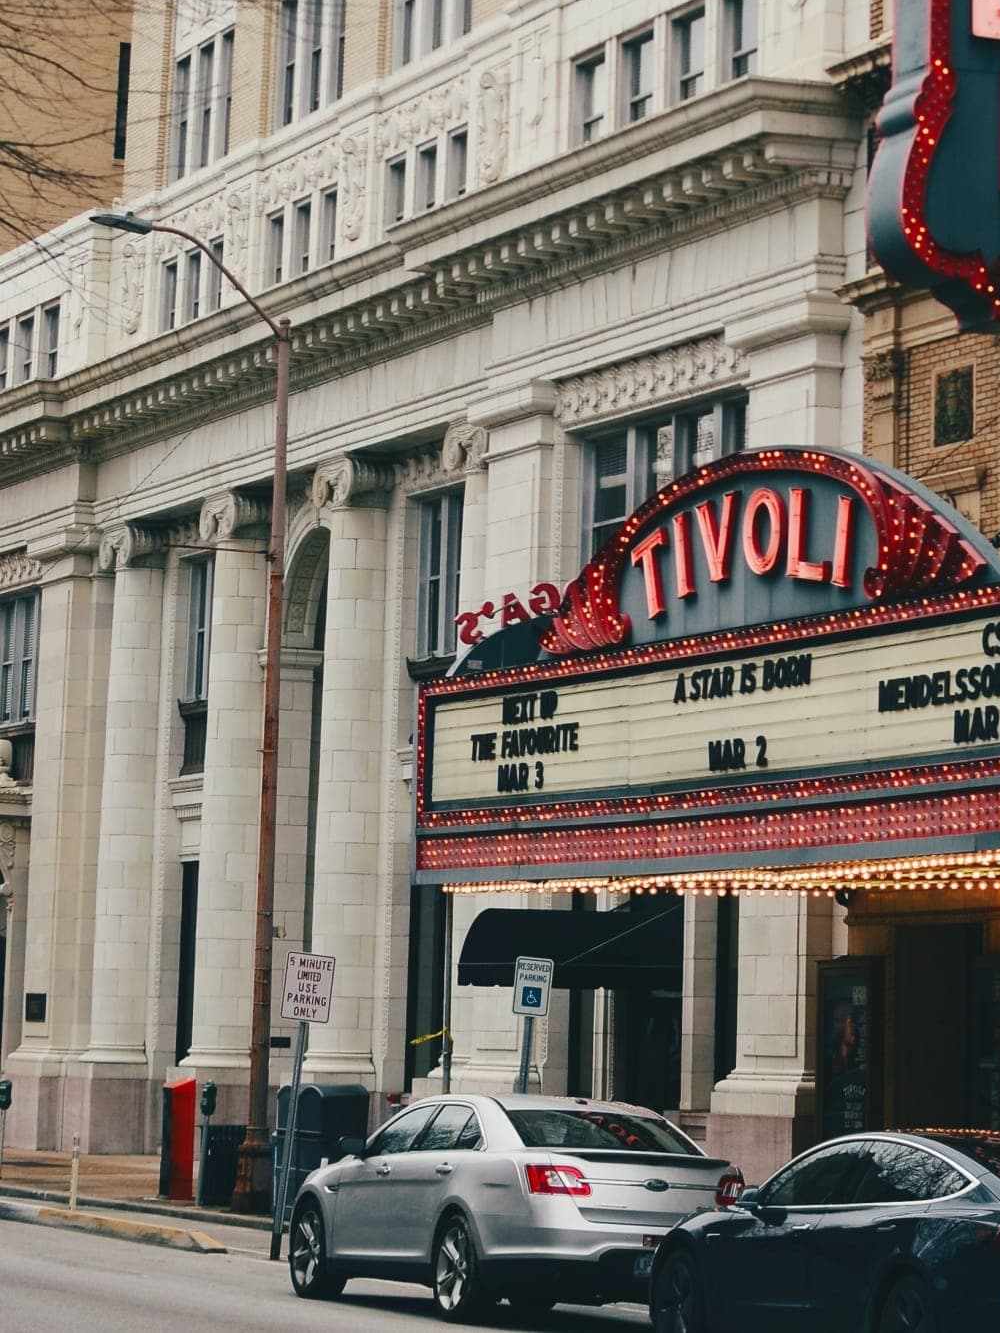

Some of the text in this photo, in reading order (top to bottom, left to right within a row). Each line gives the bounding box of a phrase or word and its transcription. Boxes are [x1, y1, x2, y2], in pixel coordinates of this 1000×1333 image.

[630, 487, 855, 620] TIVOLI
[673, 653, 813, 704] A STAR IS BORN
[502, 690, 558, 725] NEXT UP
[953, 703, 1000, 745] MAR
[471, 722, 579, 762] THE FAVOURITE
[708, 735, 768, 773] MAR 2
[497, 761, 544, 793] MAR 3
[290, 957, 332, 971] 5 MINUTE
[297, 969, 321, 982] LIMITED
[517, 962, 550, 972] RESERVED
[298, 982, 317, 994] USE
[520, 973, 547, 983] PARKING
[287, 992, 327, 1006] PARKING
[293, 1006, 317, 1018] ONLY
